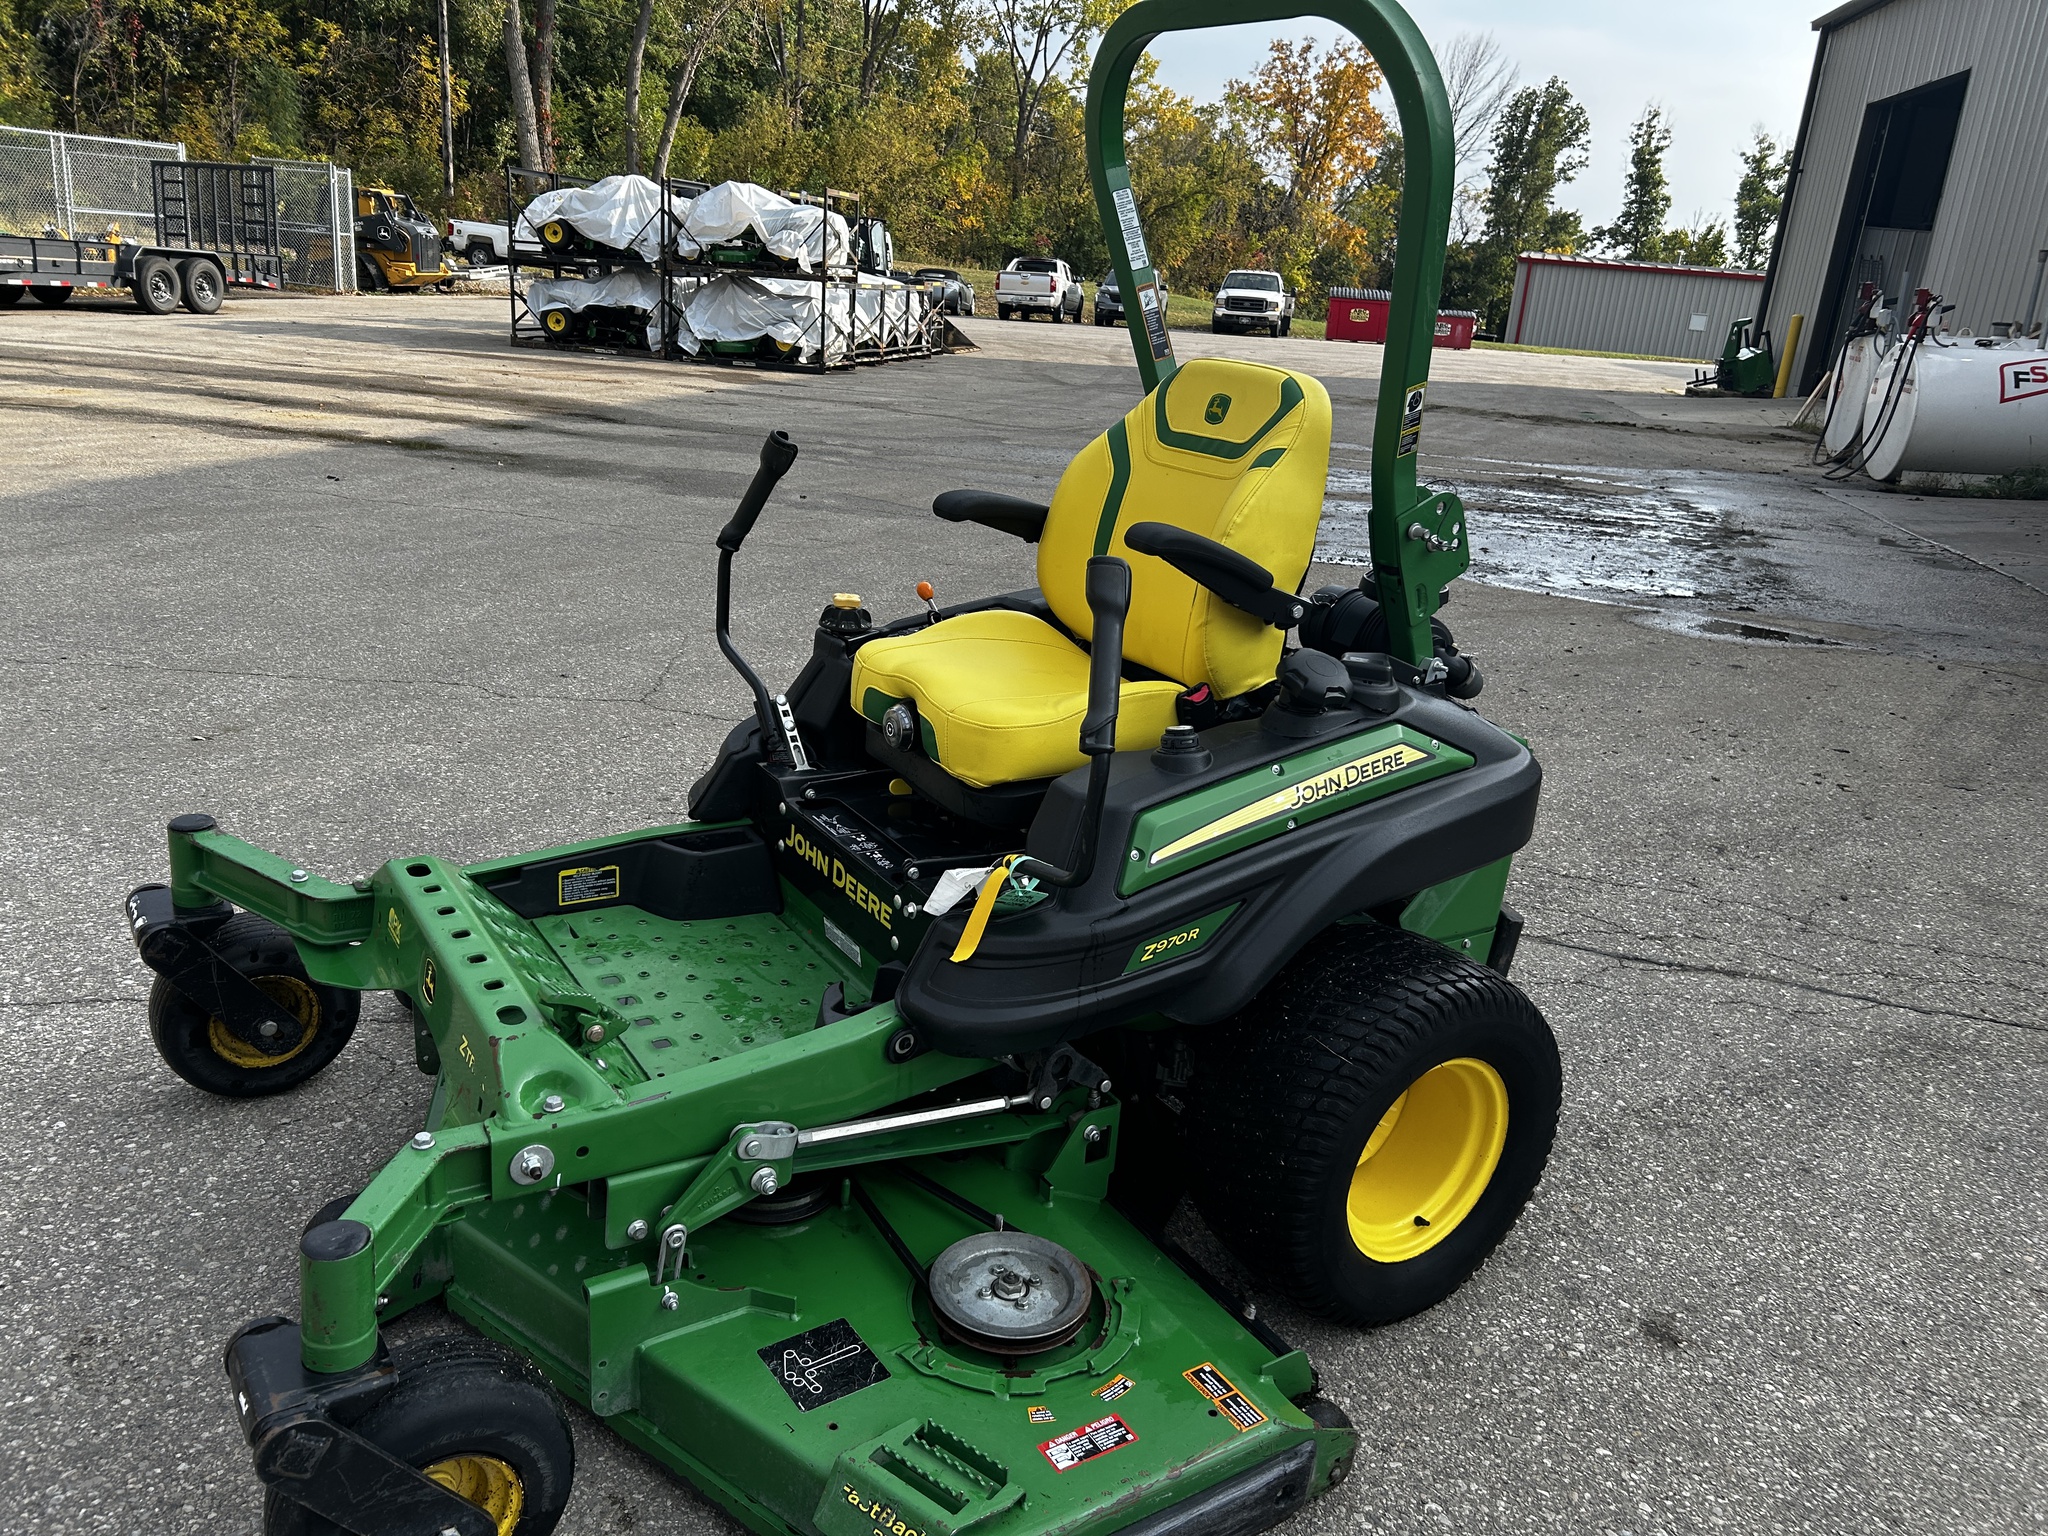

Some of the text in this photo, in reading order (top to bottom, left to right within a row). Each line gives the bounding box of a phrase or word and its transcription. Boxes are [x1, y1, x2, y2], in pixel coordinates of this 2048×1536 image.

[2013, 366, 2048, 389] FS
[1291, 751, 1405, 807] JOHN DEERE
[785, 823, 828, 877] JOHN
[832, 858, 893, 930] DEERE
[1140, 928, 1200, 962] Z970R
[1090, 1416, 1115, 1430] PELIGRO
[1054, 1431, 1079, 1445] DANGER
